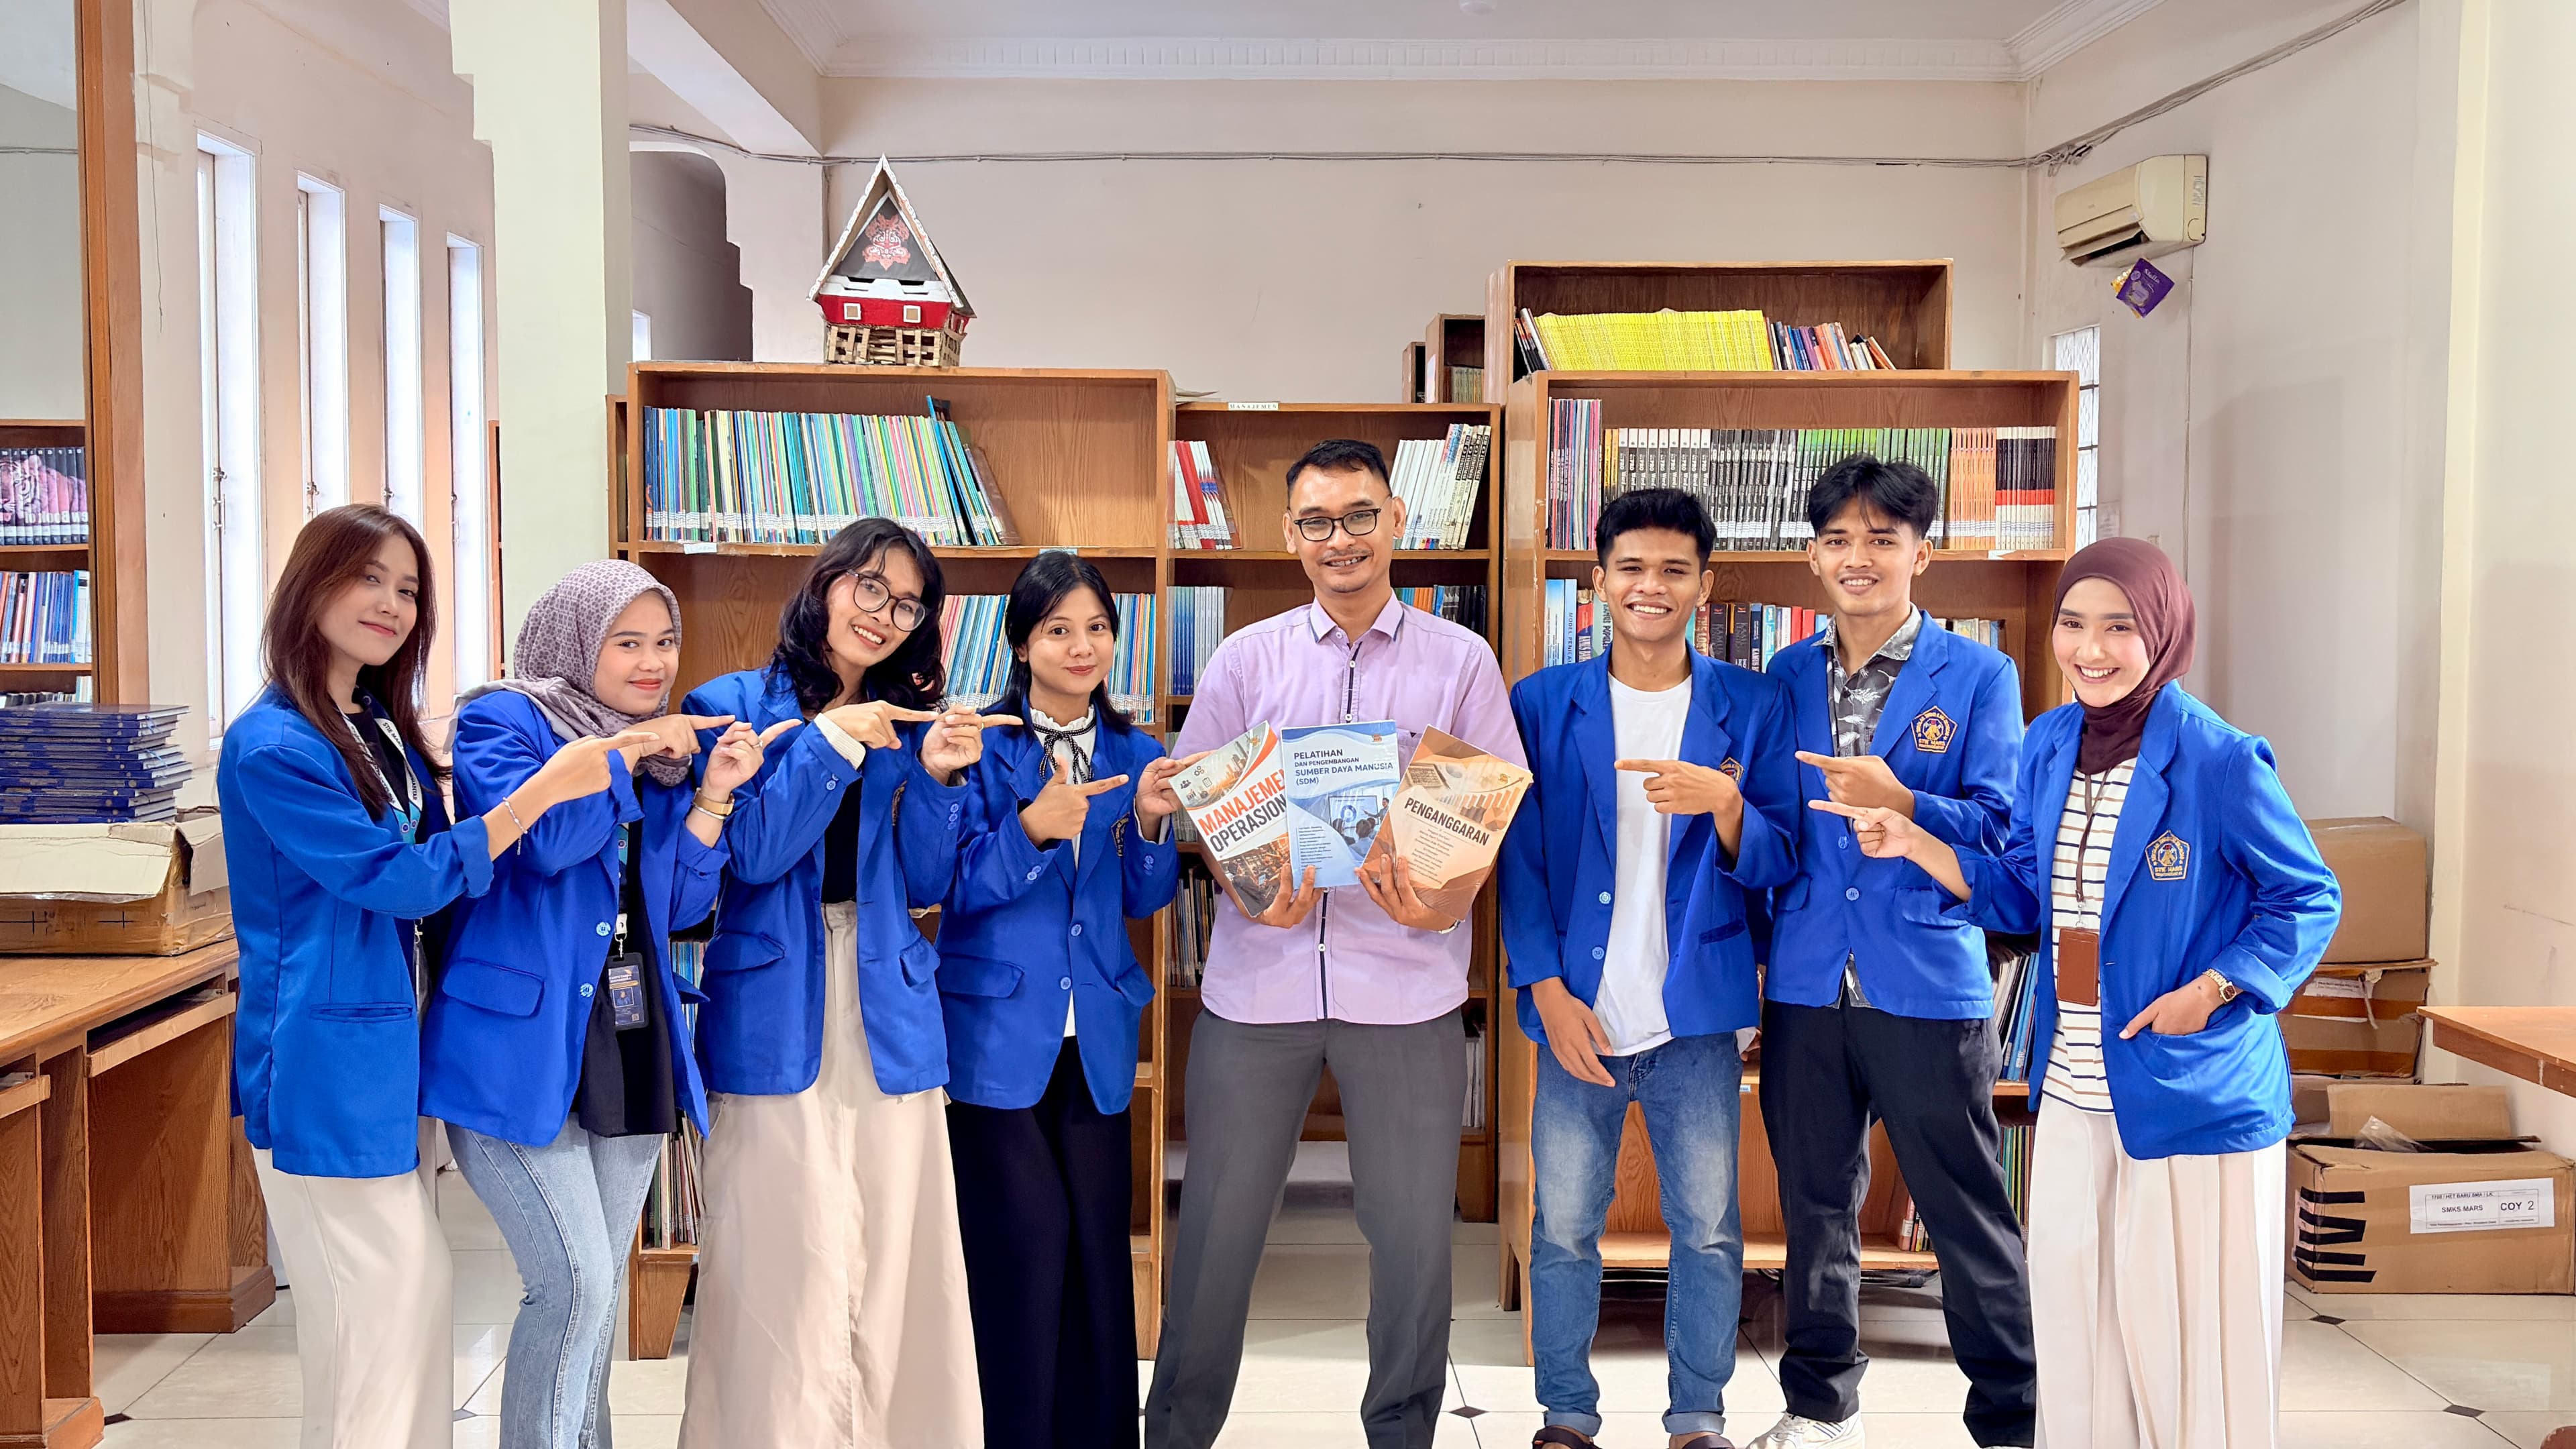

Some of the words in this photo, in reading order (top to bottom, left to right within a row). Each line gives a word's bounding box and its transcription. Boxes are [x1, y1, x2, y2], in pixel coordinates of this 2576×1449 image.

[383, 722, 392, 733] STIE
[1294, 749, 1343, 759] PELATIHAN
[1309, 757, 1359, 766] PENGEMBANGAN
[1295, 767, 1330, 776] SUMBER
[1332, 765, 1353, 773] DAYA
[1355, 762, 1393, 771] MANUSIA
[1296, 777, 1320, 786] (SDM)
[1197, 769, 1285, 836] MANAJEME
[1404, 797, 1489, 846] PENGANGGARAN
[2500, 1202, 2522, 1211] COY
[2528, 1200, 2534, 1210] 2
